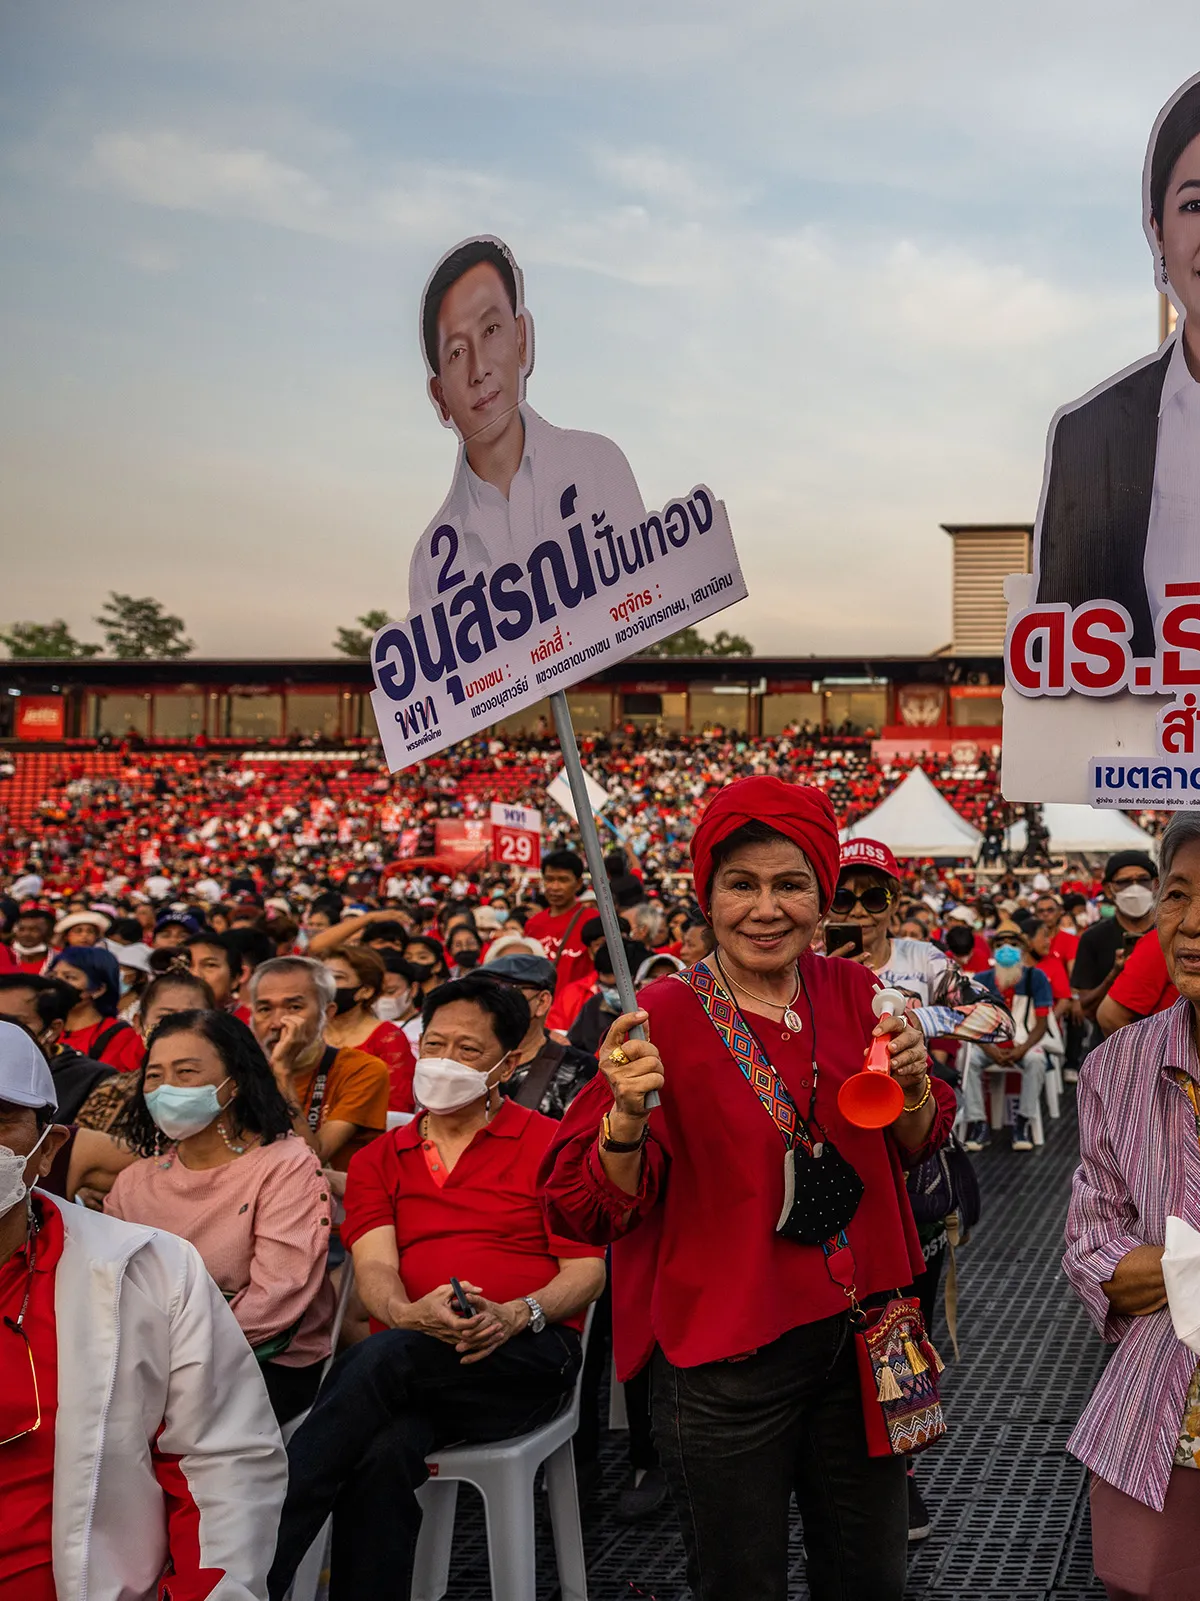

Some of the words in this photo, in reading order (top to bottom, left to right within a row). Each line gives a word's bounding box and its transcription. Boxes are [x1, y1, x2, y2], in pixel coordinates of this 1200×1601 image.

[430, 524, 467, 594] 2
[375, 483, 597, 706] อนุสรณ์
[594, 489, 713, 587] ปั้นทอง
[465, 667, 504, 698] บางเขน
[530, 625, 564, 665] หลักสี่
[609, 588, 653, 623] จตุจักร
[470, 675, 529, 719] แขวงอนุสาวรีย์
[535, 638, 611, 685] แขวงตลาดบางเขน
[691, 572, 734, 605] เสนานิคม
[394, 695, 439, 740] พท
[405, 729, 442, 752] พรรคเพื่อไทย
[501, 835, 531, 862] 29
[840, 843, 885, 861] WISS
